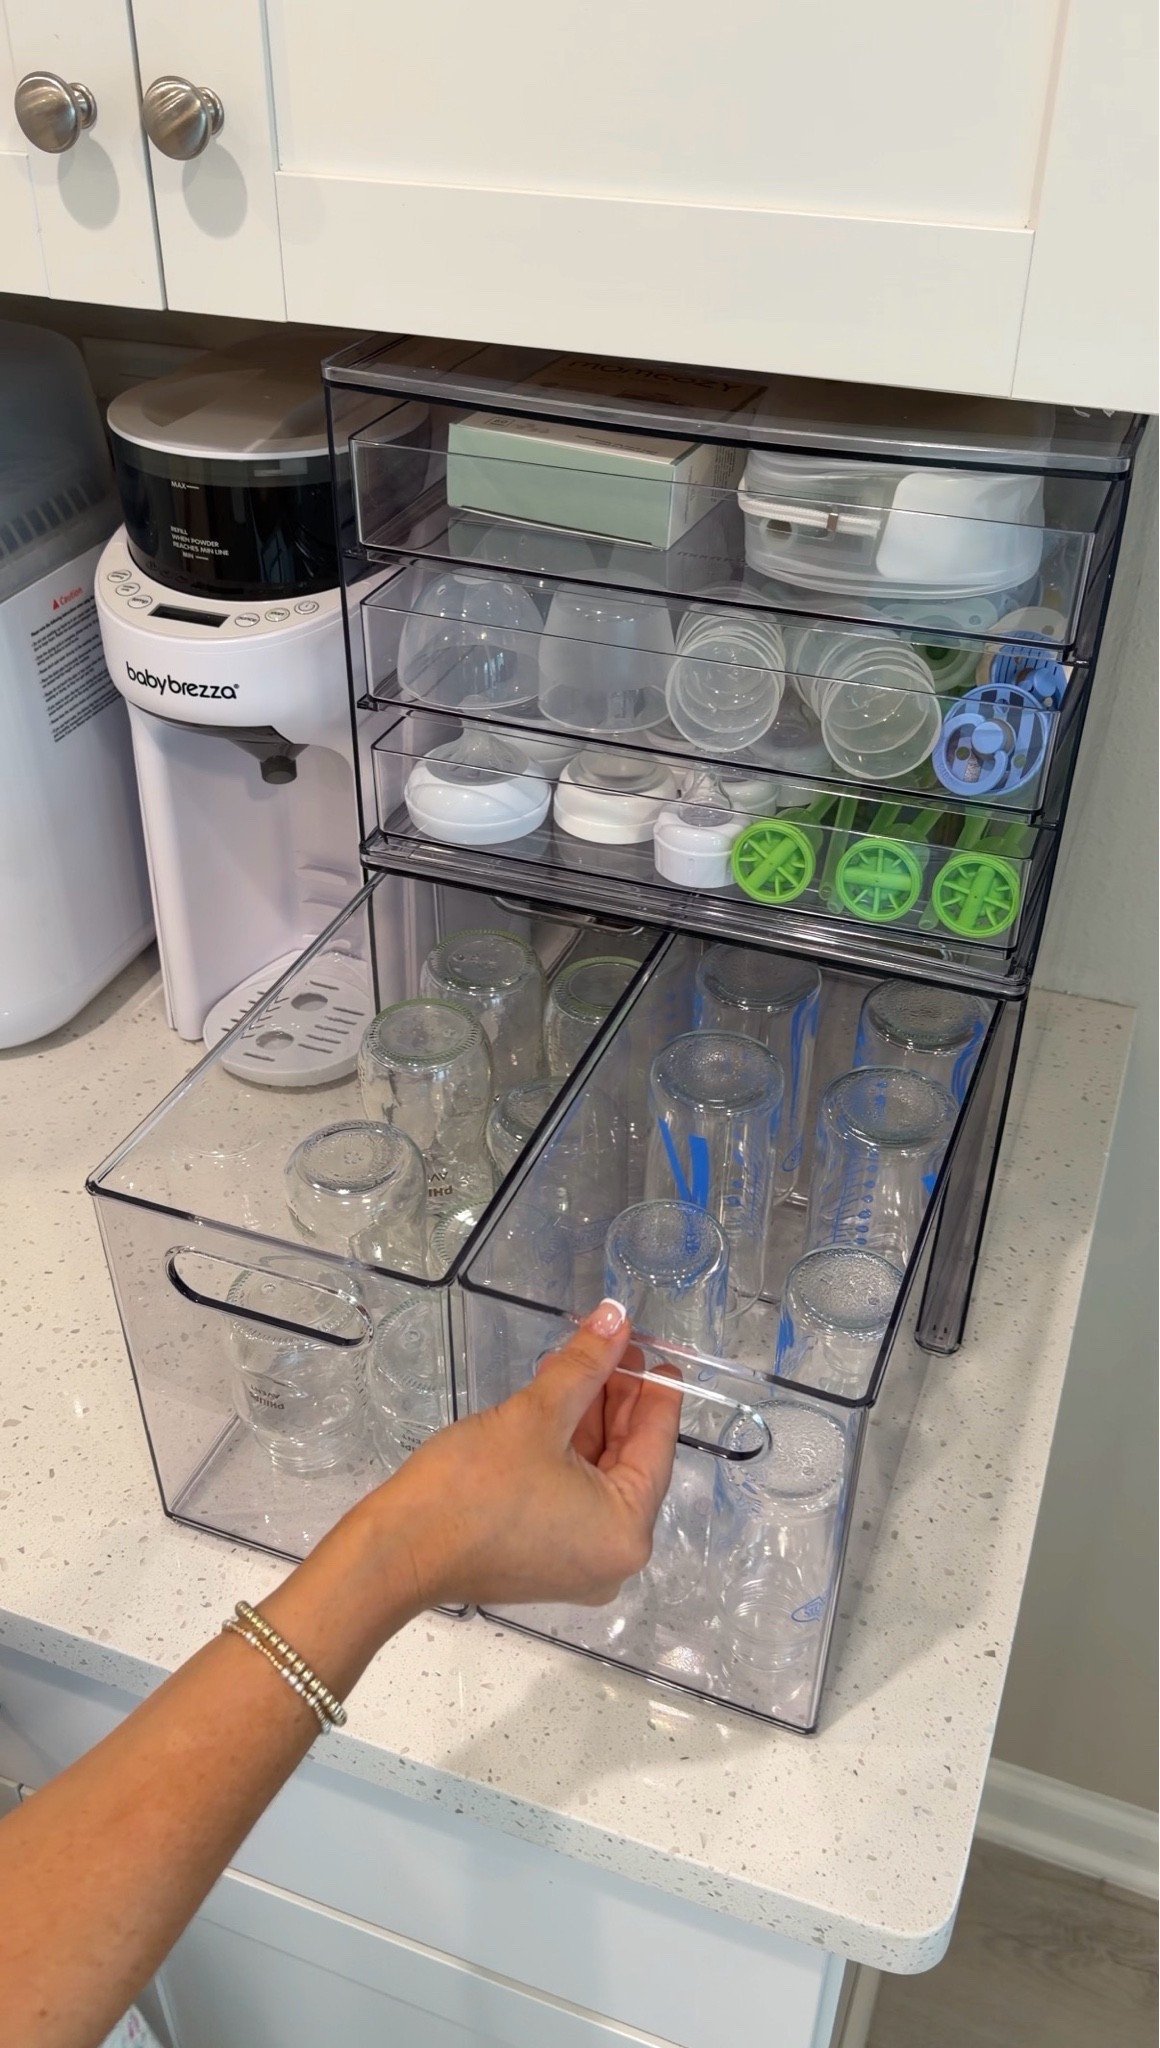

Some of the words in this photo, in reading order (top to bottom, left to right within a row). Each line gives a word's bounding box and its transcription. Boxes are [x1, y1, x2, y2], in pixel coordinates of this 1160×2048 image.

[170, 480, 187, 490] MAX
[170, 525, 189, 536] REFILL
[171, 532, 191, 543] WHEN
[190, 537, 220, 548] POWDER
[172, 541, 200, 552] REACHES
[200, 546, 214, 556] MIN
[214, 548, 230, 556] LINE
[182, 551, 194, 559] MIN
[60, 587, 83, 606] Caution
[428, 1184, 453, 1197] PHI
